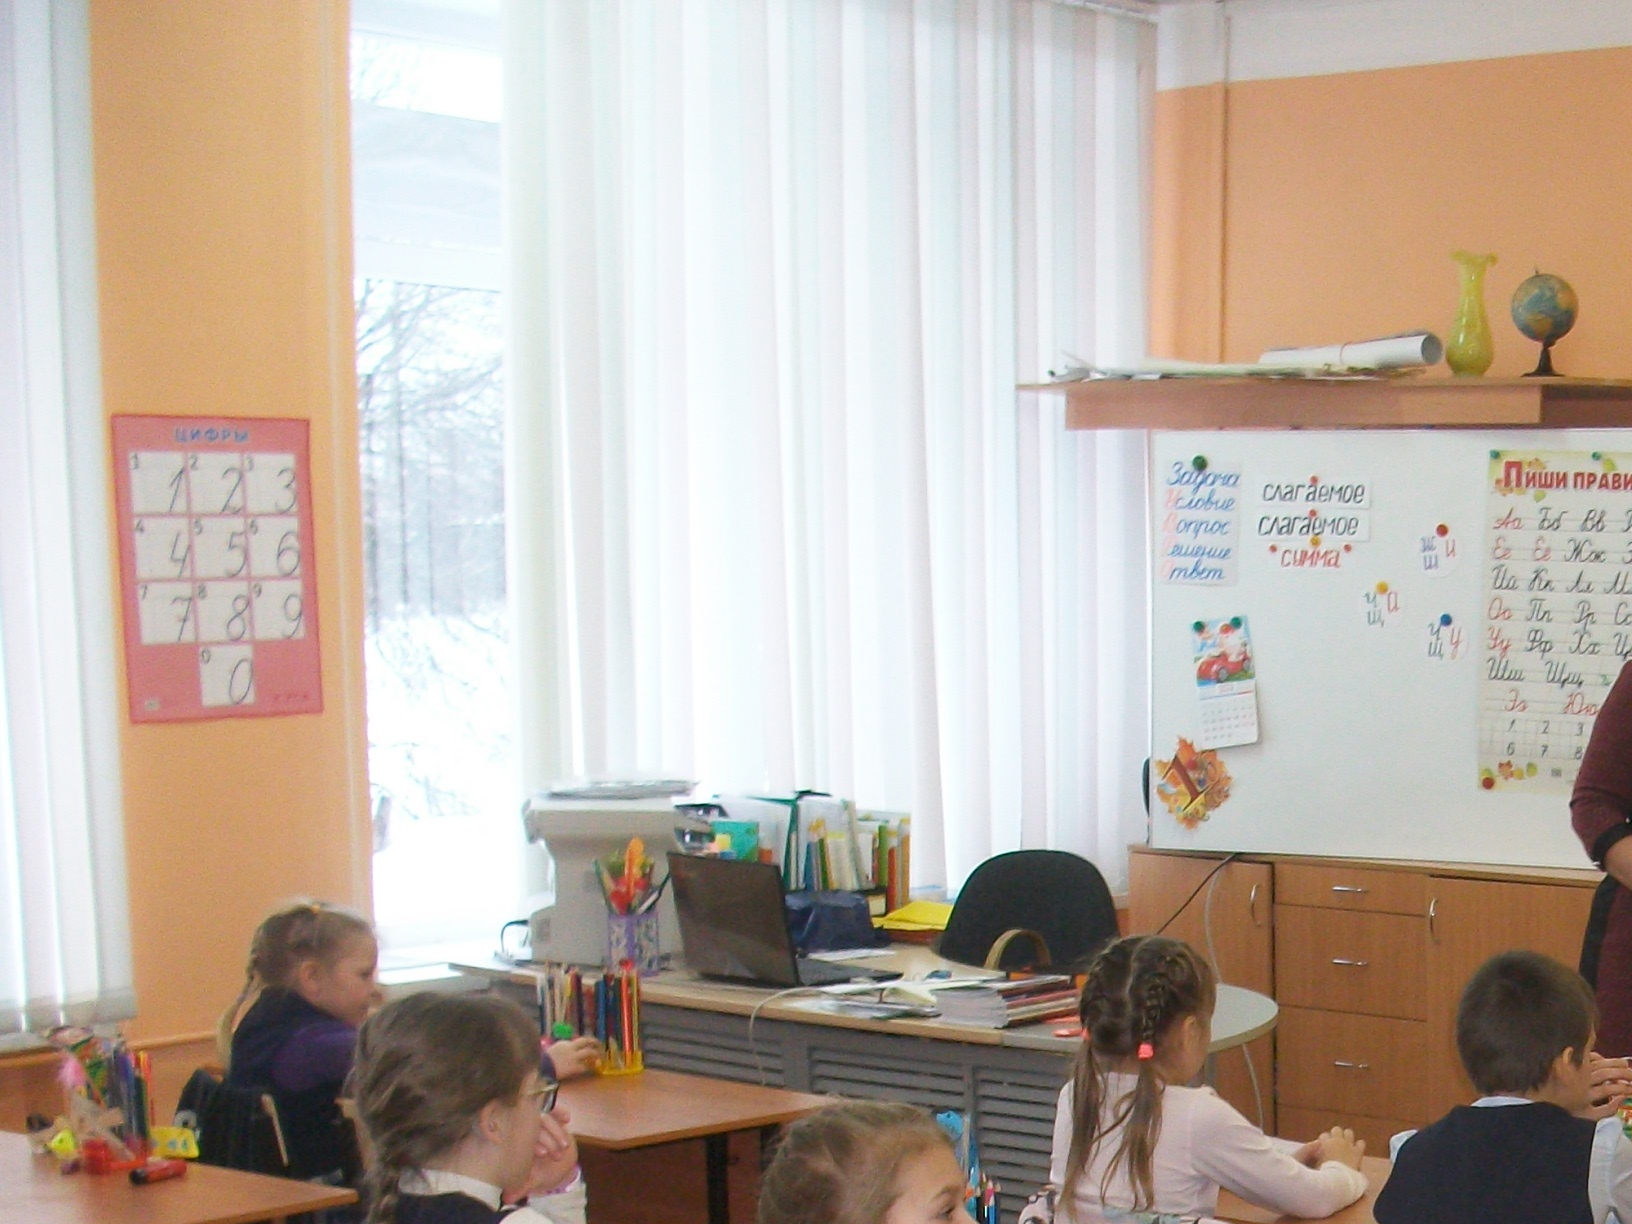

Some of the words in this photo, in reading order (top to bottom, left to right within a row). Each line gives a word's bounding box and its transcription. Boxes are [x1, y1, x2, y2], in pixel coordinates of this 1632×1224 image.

[174, 427, 249, 443] ЦИФРЫ
[169, 466, 185, 513] 1
[222, 466, 243, 514] 2
[275, 467, 296, 515] 3
[1166, 461, 1240, 495] Задача
[1262, 482, 1365, 504] слагаемое
[1257, 514, 1359, 536] слагаемое
[1492, 506, 1524, 530] Аа
[1537, 506, 1569, 531] Бб
[1580, 508, 1607, 533] Вв
[170, 532, 191, 578] 4
[225, 531, 248, 578] 5
[276, 530, 300, 577] 6
[1563, 538, 1607, 564] Жж
[1527, 566, 1554, 592] Кк
[1565, 570, 1595, 593] Лл
[171, 596, 193, 642] 7
[226, 595, 250, 642] 8
[281, 593, 303, 639] 9
[1487, 597, 1514, 621] Оо
[1525, 598, 1553, 623] Пп
[1573, 599, 1597, 631] Рр
[1613, 601, 1632, 627] Сс
[1487, 627, 1512, 659] Уу
[1524, 628, 1553, 660] Фф
[1569, 630, 1602, 655] Хх
[229, 658, 253, 705] 0
[1486, 657, 1525, 682] Шш
[1544, 659, 1585, 689] Щщ
